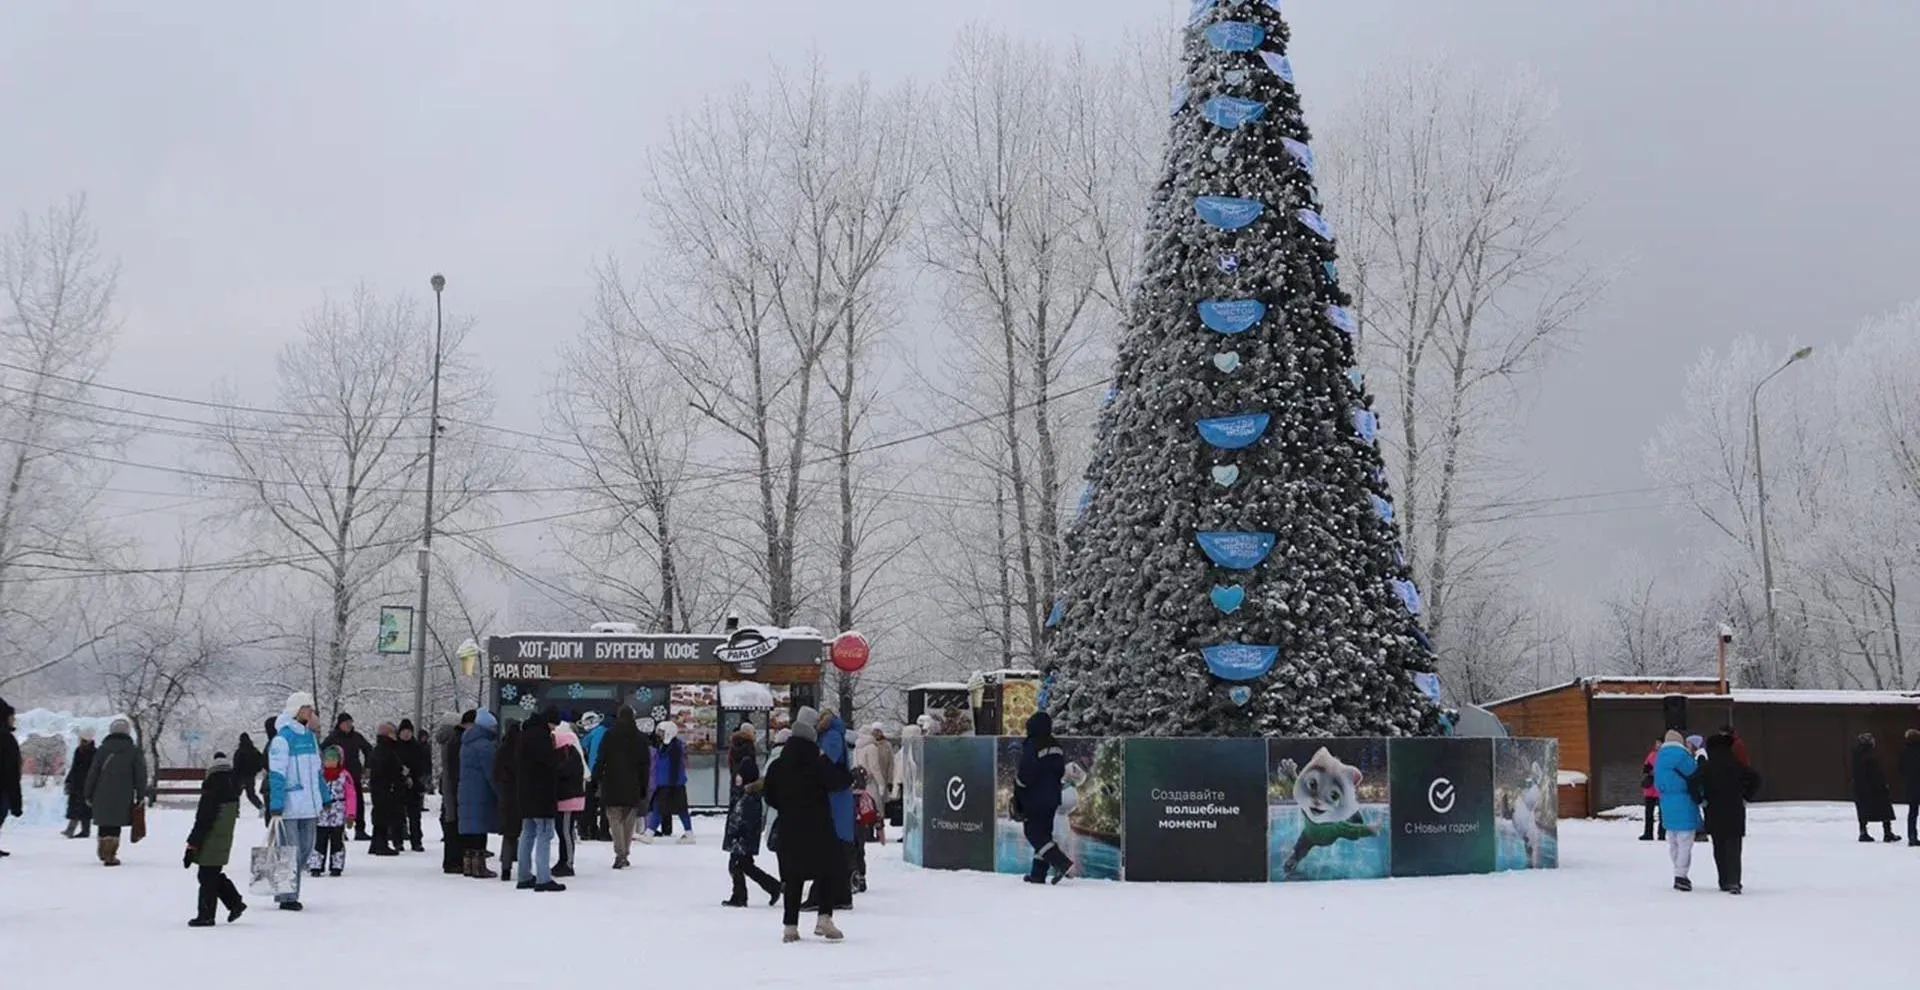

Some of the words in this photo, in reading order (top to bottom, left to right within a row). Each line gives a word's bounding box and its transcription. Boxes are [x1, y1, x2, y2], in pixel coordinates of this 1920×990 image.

[518, 641, 583, 660] ХОТ-ДОГИ
[595, 642, 655, 659] БУРГЕРЫ
[664, 642, 700, 659] КОФЕ
[493, 663, 520, 679] PAPA
[522, 663, 551, 679] GRILL
[1151, 787, 1225, 802] Создавайте
[1165, 803, 1240, 815] волшебные
[1158, 819, 1217, 829] моменты
[1405, 822, 1412, 834] С
[1414, 823, 1447, 834] Новым
[1449, 821, 1480, 834] годом!
